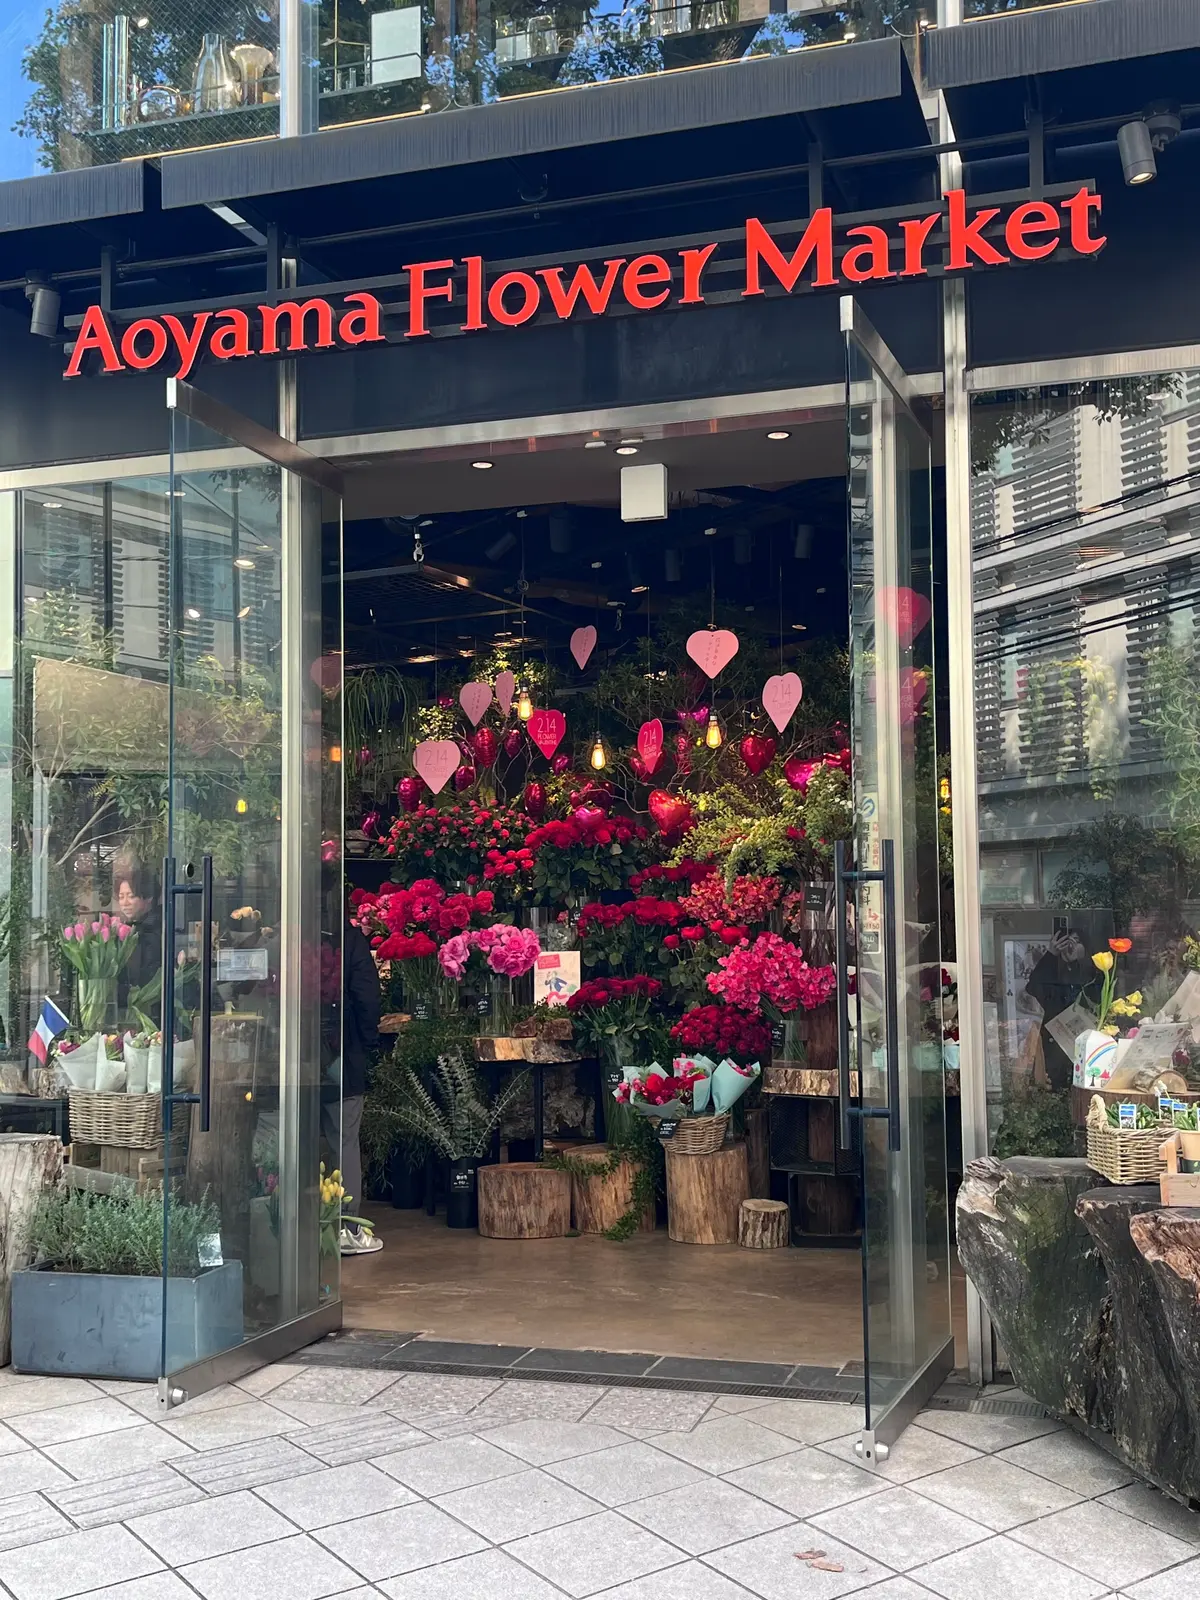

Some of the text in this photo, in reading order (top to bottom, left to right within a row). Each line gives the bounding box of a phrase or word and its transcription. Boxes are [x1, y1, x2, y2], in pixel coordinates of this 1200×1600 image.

[63, 187, 1107, 379] Aoyama Flower Market
